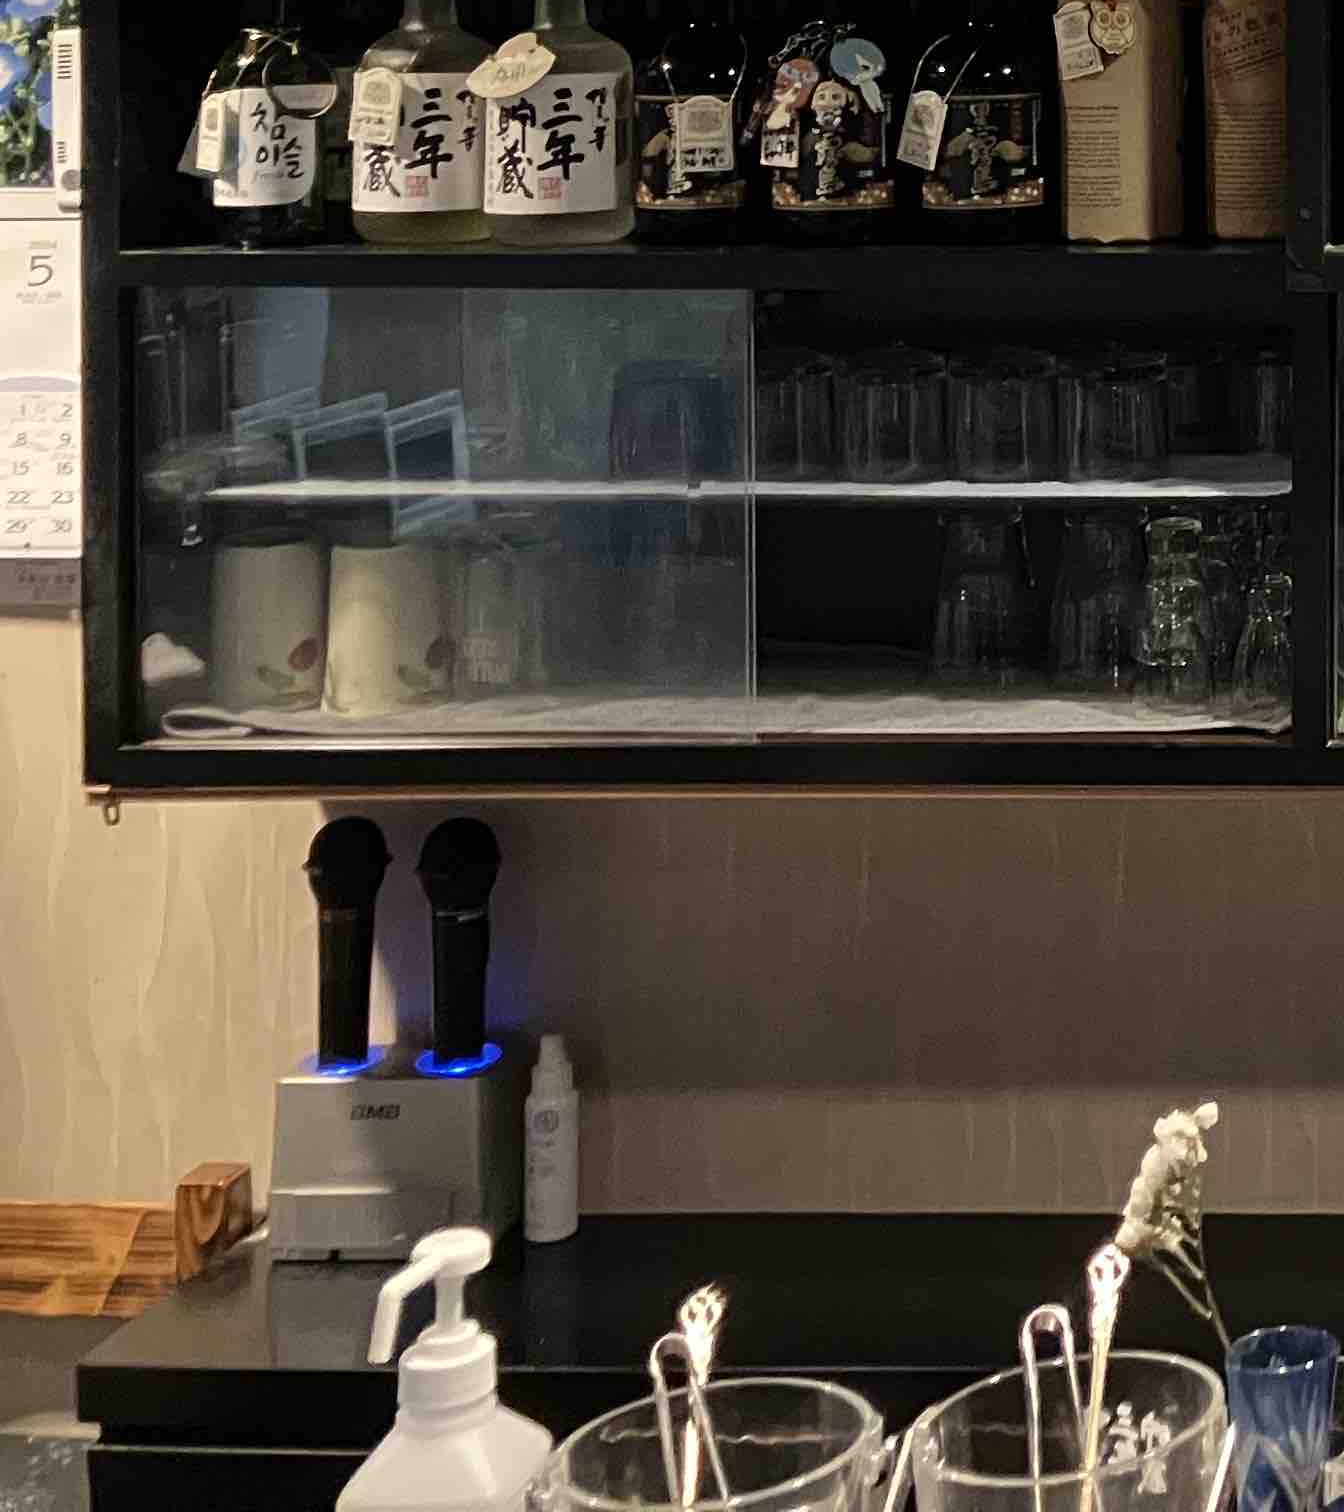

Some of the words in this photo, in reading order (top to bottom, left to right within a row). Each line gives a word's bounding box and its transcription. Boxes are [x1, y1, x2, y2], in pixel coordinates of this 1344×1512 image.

[250, 101, 305, 179] 참이슬
[404, 87, 453, 179] 三年
[537, 87, 586, 180] 三年
[27, 254, 54, 287] 5
